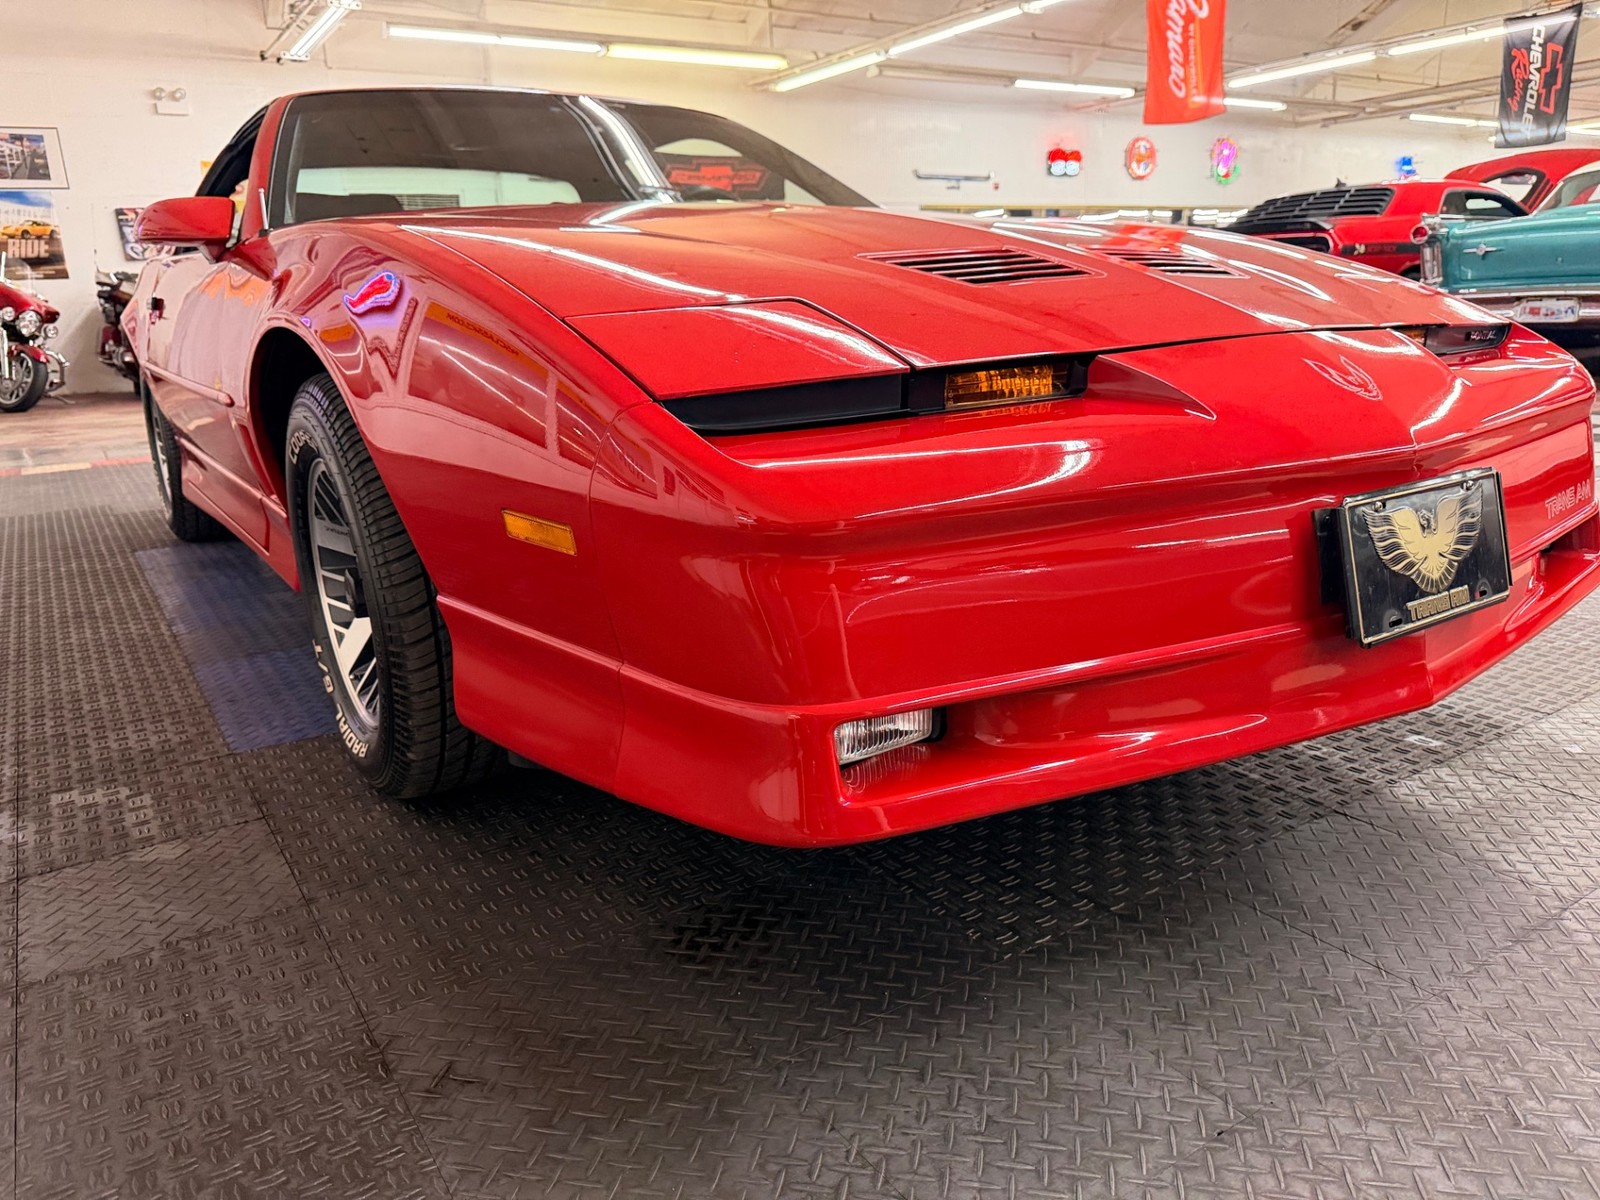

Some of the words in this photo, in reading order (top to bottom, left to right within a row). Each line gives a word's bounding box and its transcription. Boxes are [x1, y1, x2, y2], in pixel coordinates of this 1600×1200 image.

[1507, 47, 1529, 112] Racing
[7, 239, 49, 259] RIDE
[1545, 486, 1575, 519] TRANS
[1576, 479, 1591, 504] AM
[1406, 591, 1451, 621] TRANS
[1451, 585, 1470, 608] AM
[335, 703, 369, 758] RADIAL
